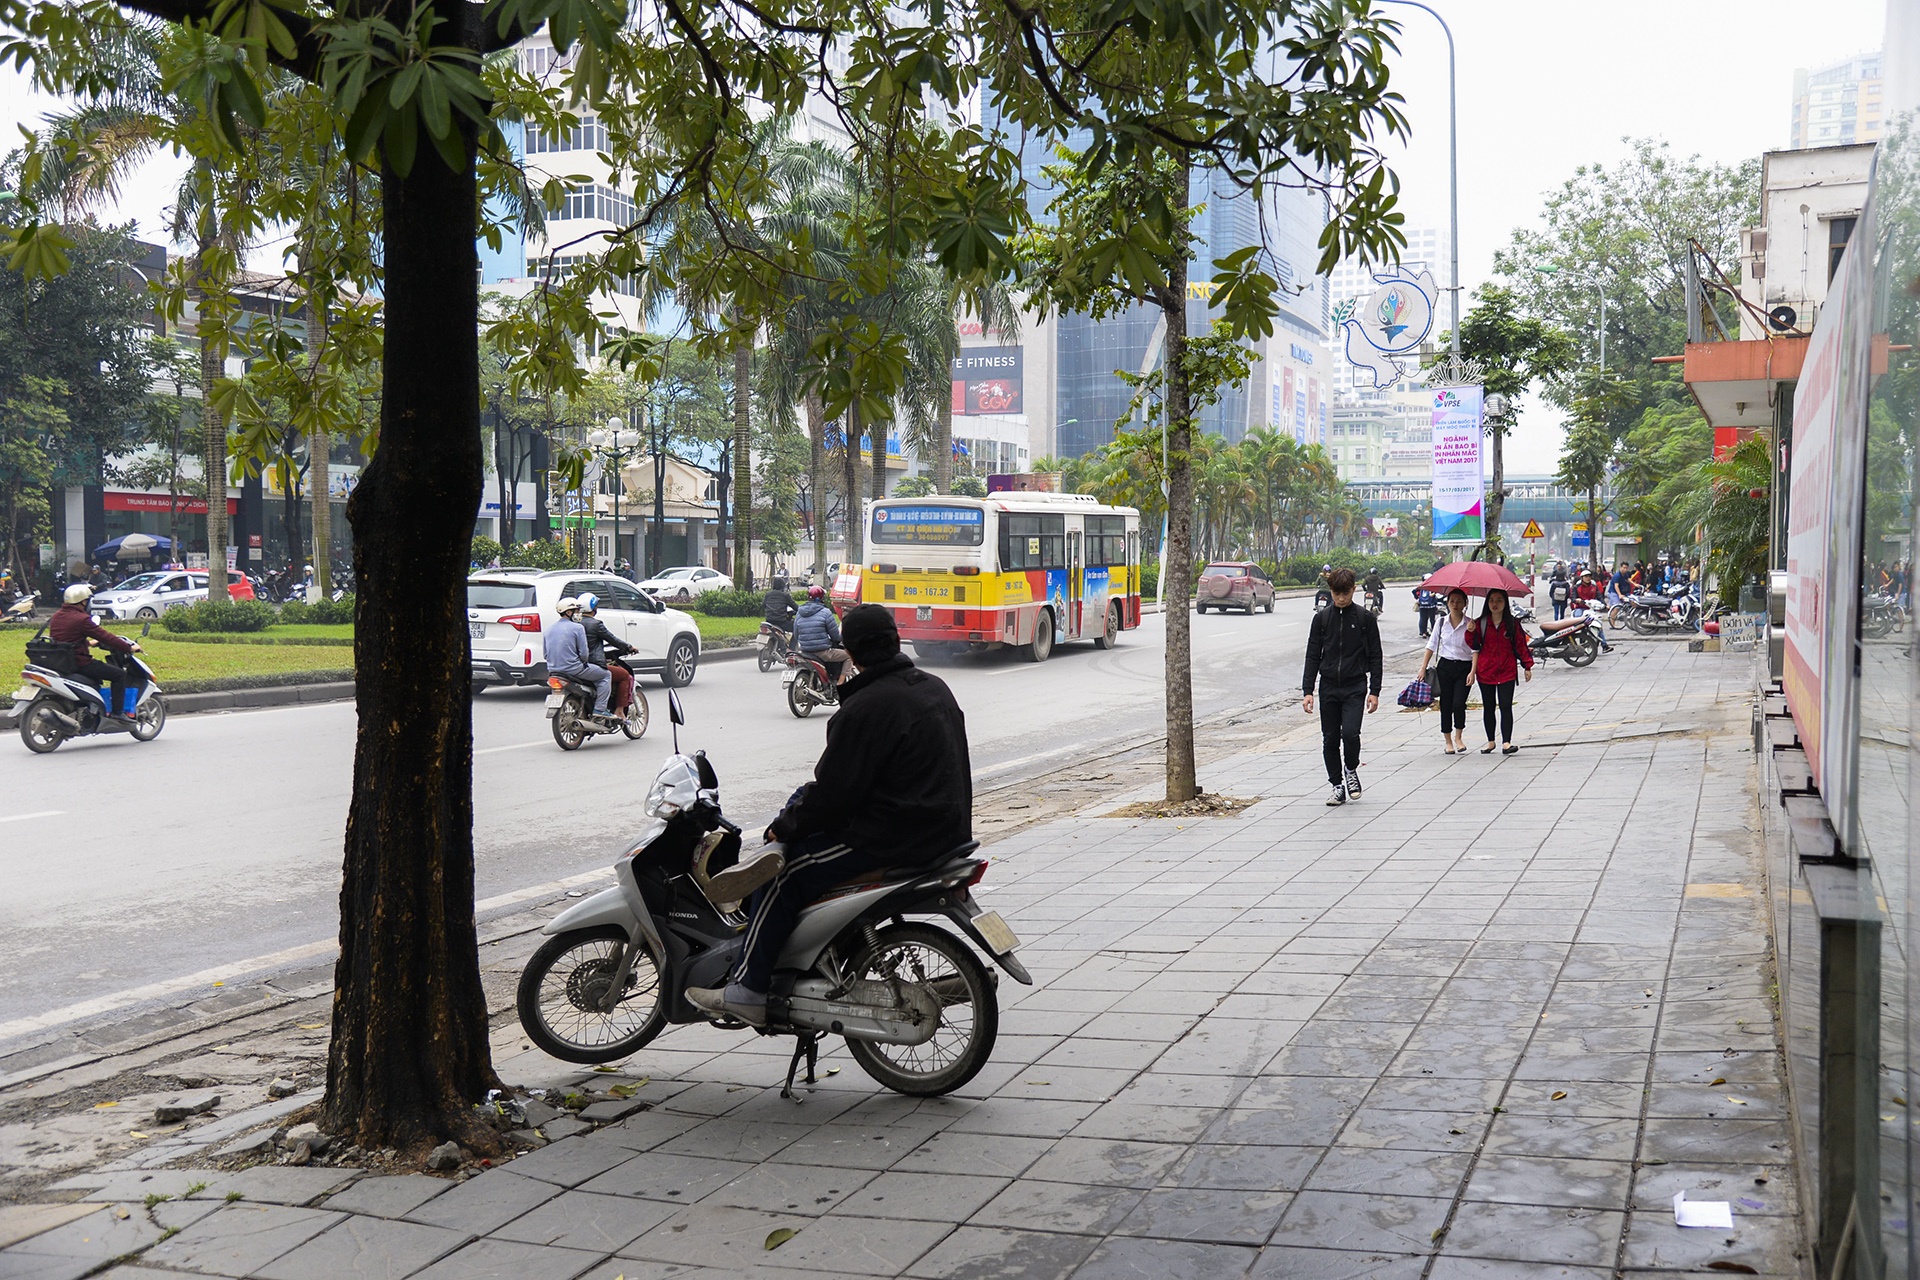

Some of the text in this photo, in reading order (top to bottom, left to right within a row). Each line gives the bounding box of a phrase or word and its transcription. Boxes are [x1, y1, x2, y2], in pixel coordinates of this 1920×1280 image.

[967, 356, 1016, 368] FITNESS
[979, 396, 1013, 410] CGV
[1443, 399, 1461, 408] VPSE
[1470, 441, 1478, 449] BÌ
[1442, 449, 1461, 457] NHÃN
[1434, 457, 1447, 466] VIỆT
[127, 498, 145, 506] TRUNG
[904, 586, 918, 596] 29B
[925, 587, 949, 597] 167.32
[668, 911, 699, 919] HONDA
